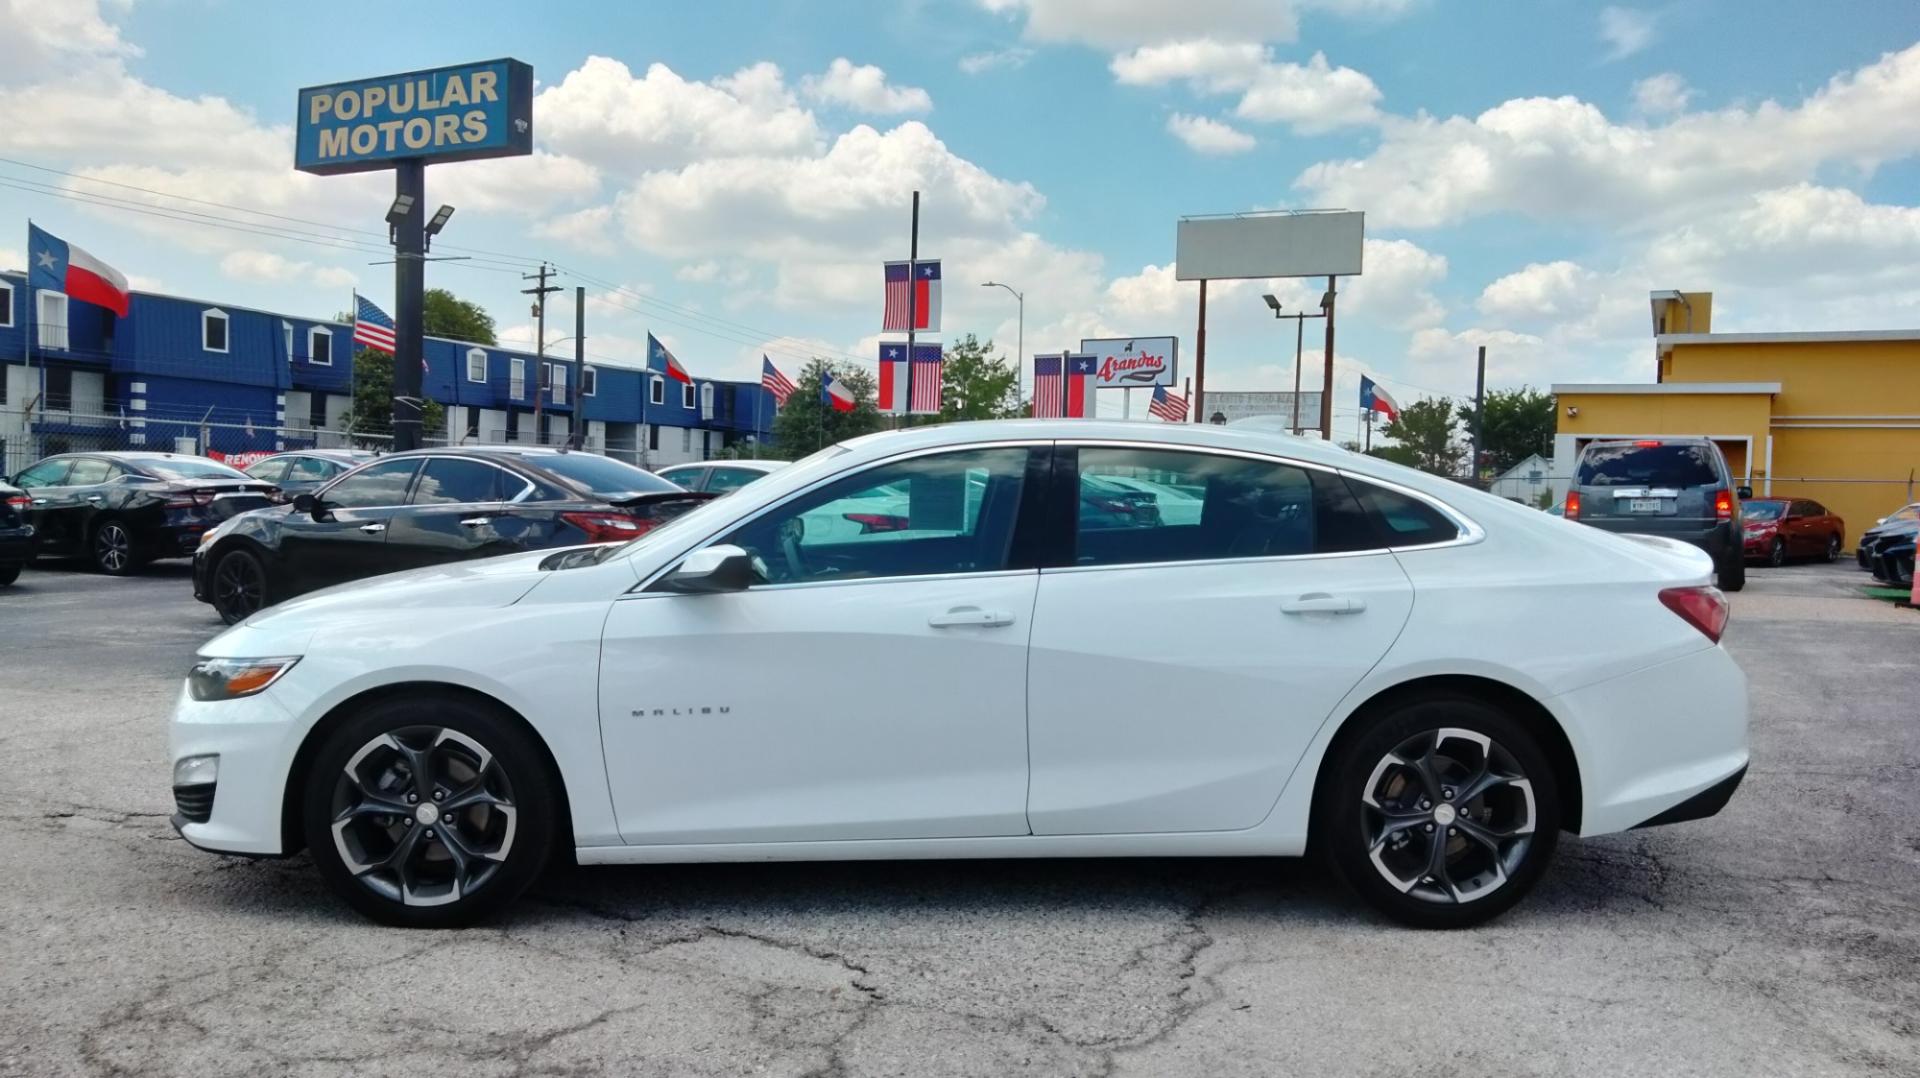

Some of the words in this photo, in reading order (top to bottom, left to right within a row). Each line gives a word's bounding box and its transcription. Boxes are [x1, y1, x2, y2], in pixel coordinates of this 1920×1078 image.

[310, 71, 498, 125] POPULAR
[318, 110, 488, 158] MOTORS
[1096, 350, 1163, 382] Arandas
[224, 453, 271, 466] RENOV
[631, 706, 730, 717] MALIBU
